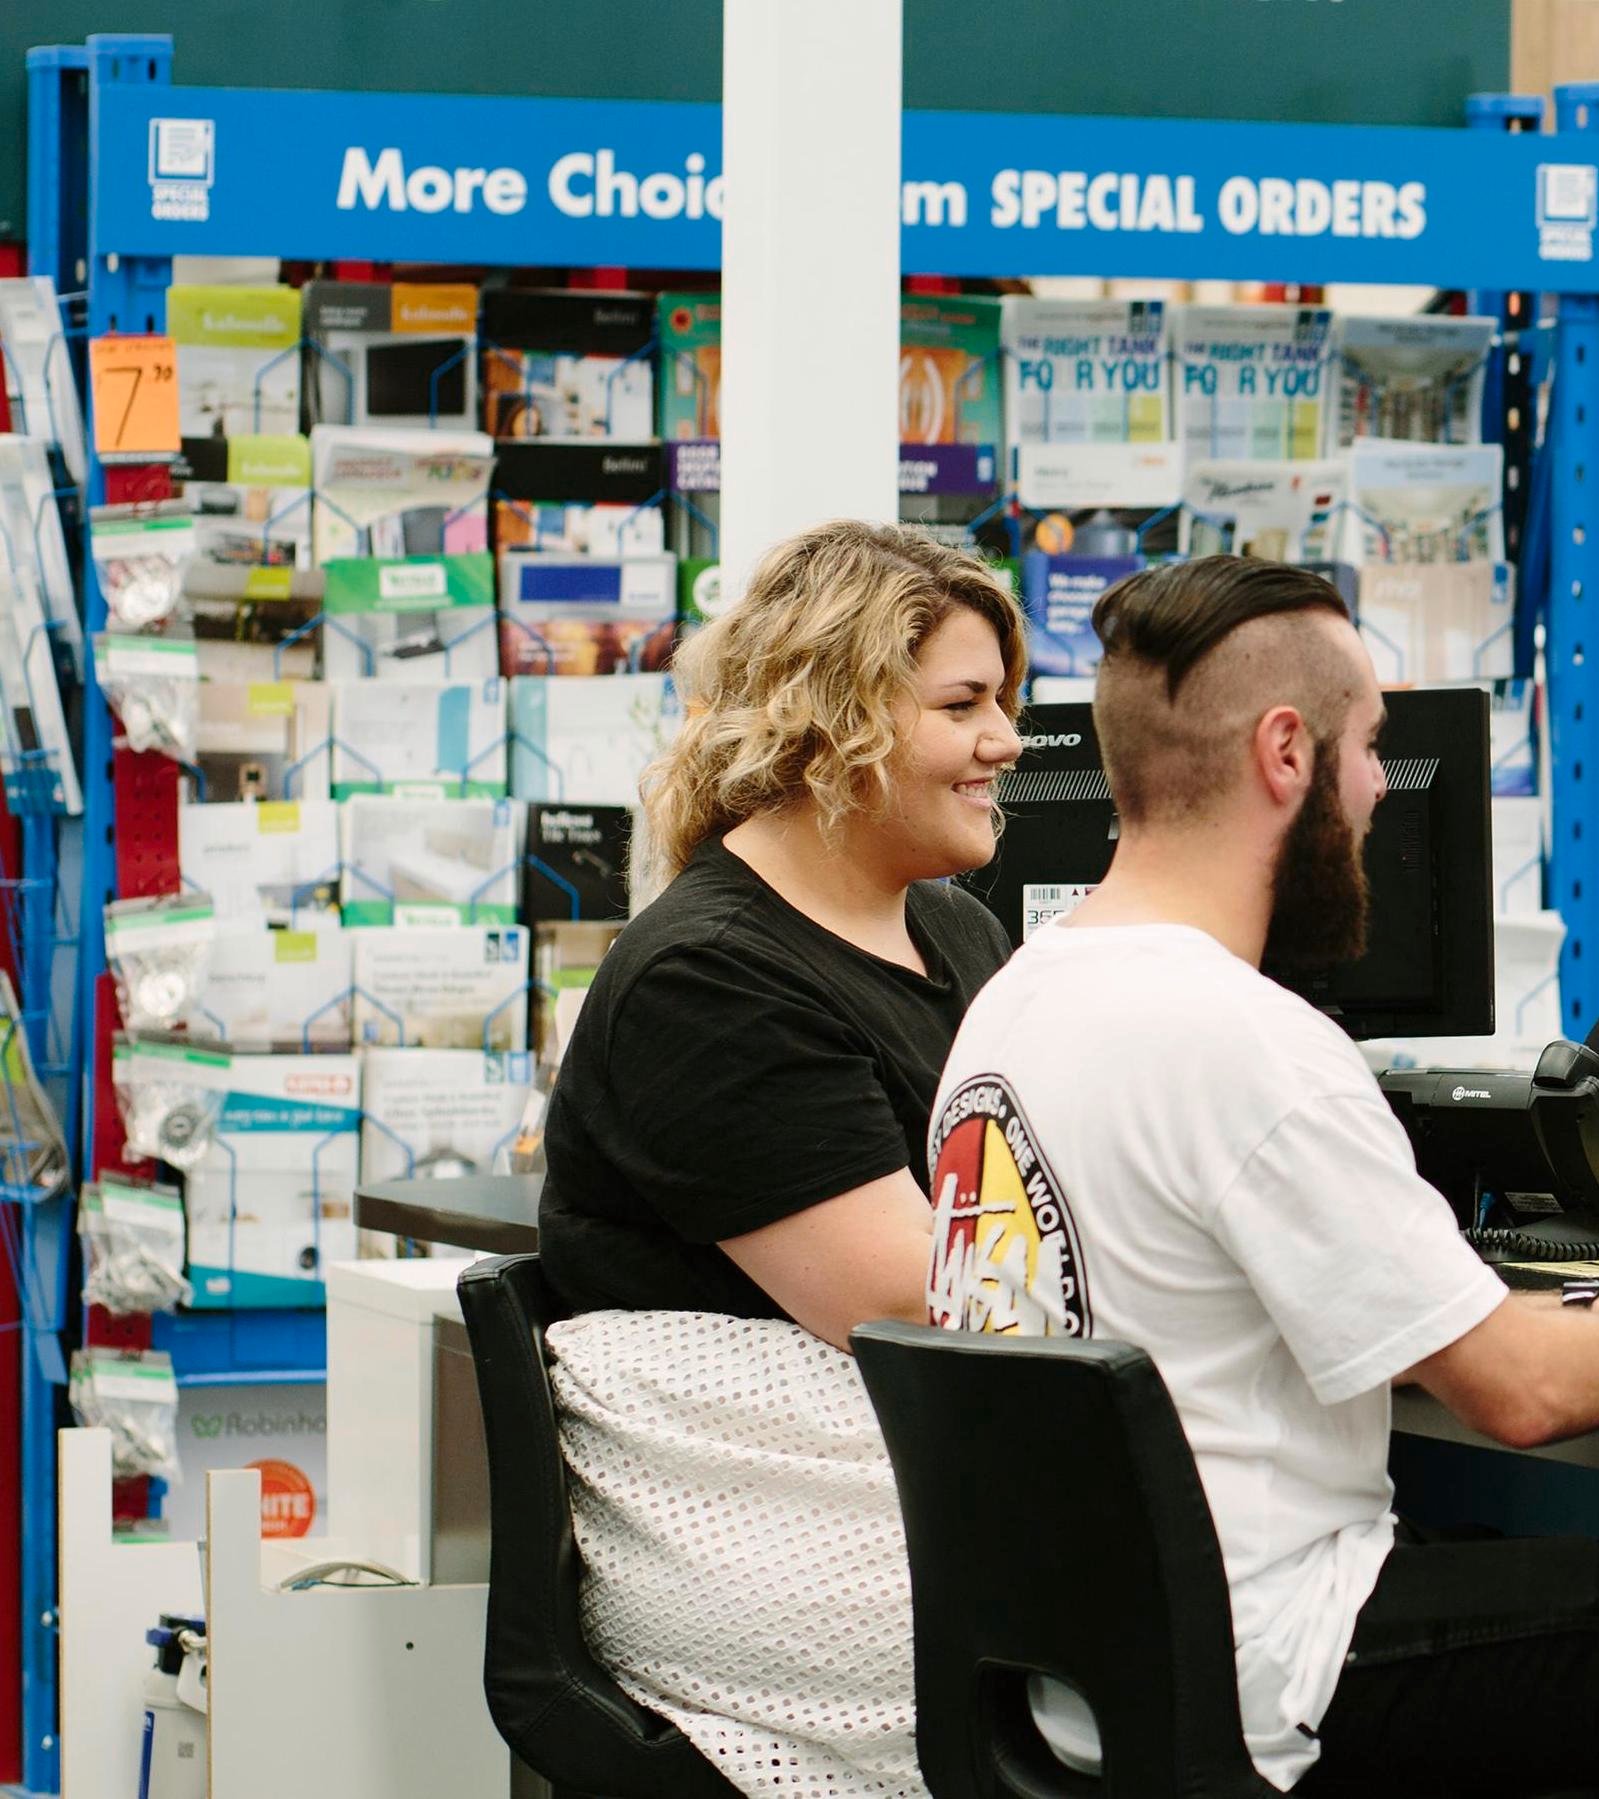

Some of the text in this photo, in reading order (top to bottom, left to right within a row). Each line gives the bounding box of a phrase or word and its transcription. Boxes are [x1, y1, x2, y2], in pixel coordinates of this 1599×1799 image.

[337, 147, 527, 214] More
[991, 169, 1203, 232] SPECIAL
[1218, 176, 1426, 239] ORDERS
[1463, 1089, 1492, 1099] MITEL
[1005, 1116, 1036, 1178] ONE
